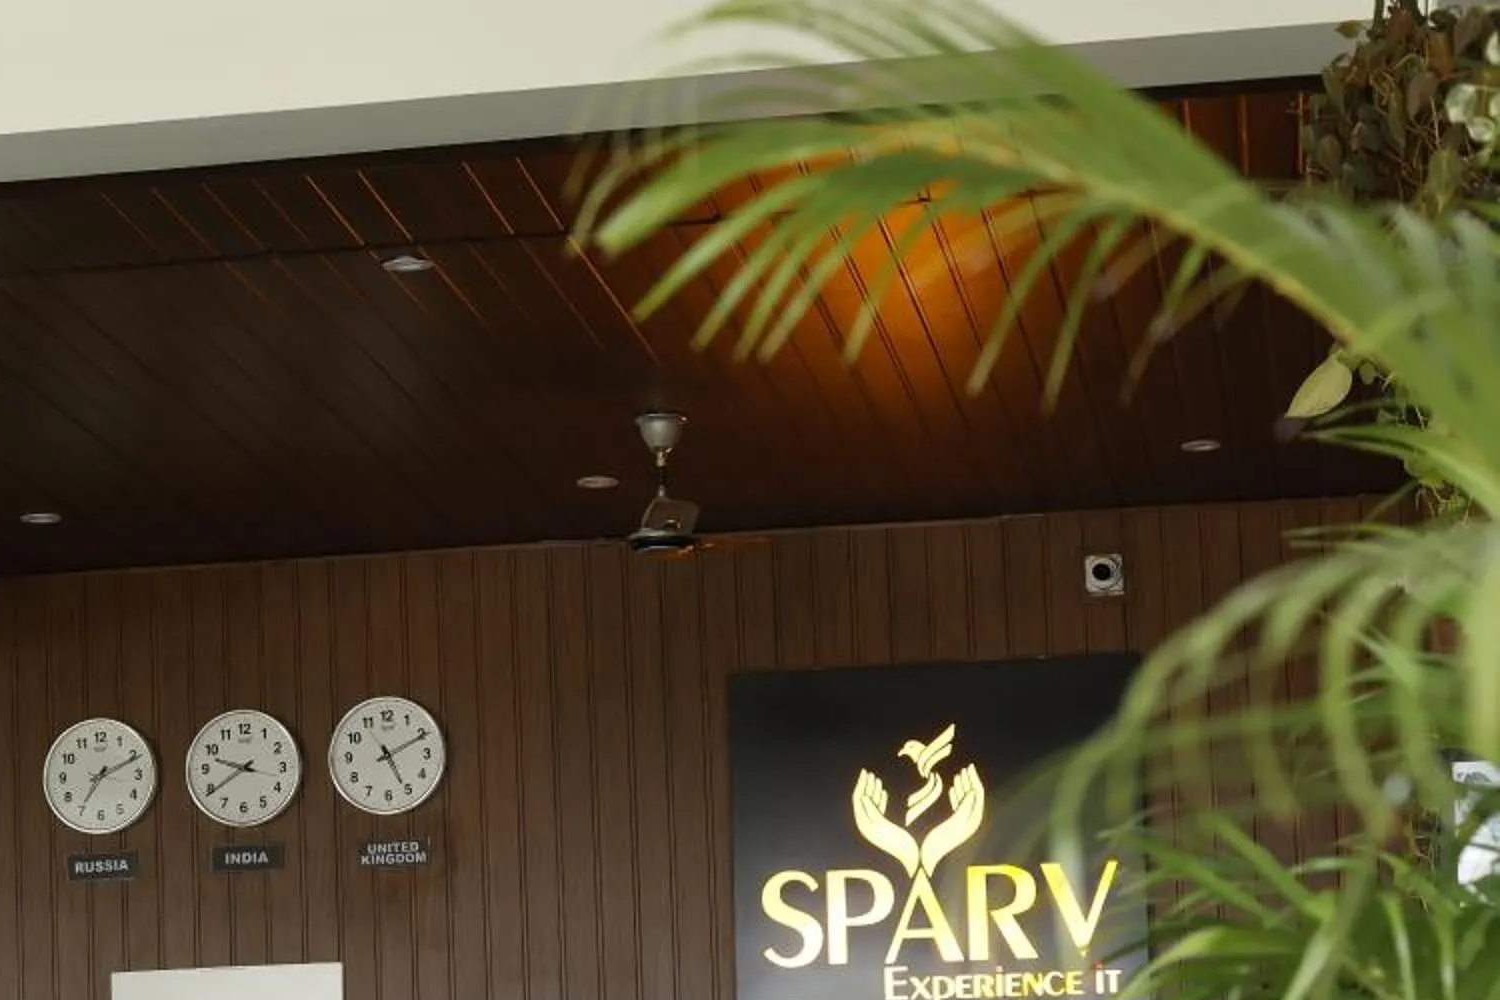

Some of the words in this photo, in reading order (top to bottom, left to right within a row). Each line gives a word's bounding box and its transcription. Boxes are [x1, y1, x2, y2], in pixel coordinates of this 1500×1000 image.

[380, 710, 394, 722] 12
[404, 715, 409, 726] 1
[363, 717, 373, 728] 11
[221, 729, 231, 740] 11
[238, 724, 251, 735] 12
[261, 728, 267, 739] 1
[94, 732, 106, 742] 12
[117, 736, 122, 746] 1
[348, 732, 361, 744] 10
[76, 738, 87, 749] 11
[274, 742, 282, 754] 2
[205, 744, 218, 756] 10
[424, 748, 431, 760] 3
[63, 753, 75, 764] 10
[345, 752, 352, 763] 9
[202, 764, 209, 775] 9
[280, 762, 287, 773] 3
[59, 772, 66, 783] 9
[134, 769, 142, 780] 3
[351, 772, 359, 783] 8
[418, 768, 426, 779] 4
[274, 782, 281, 792] 4
[365, 786, 372, 796] 7
[404, 784, 412, 795] 5
[130, 789, 137, 799] 4
[385, 790, 392, 801] 6
[221, 798, 228, 808] 7
[240, 802, 248, 812] 6
[260, 796, 266, 808] 5
[78, 805, 85, 816] 7
[116, 804, 124, 814] 5
[98, 810, 104, 820] 6
[368, 842, 418, 854] UNITED
[225, 851, 268, 864] INDIA
[361, 852, 426, 865] KINGDOM
[75, 860, 129, 874] RUSSIA
[761, 861, 1119, 968] SPARV
